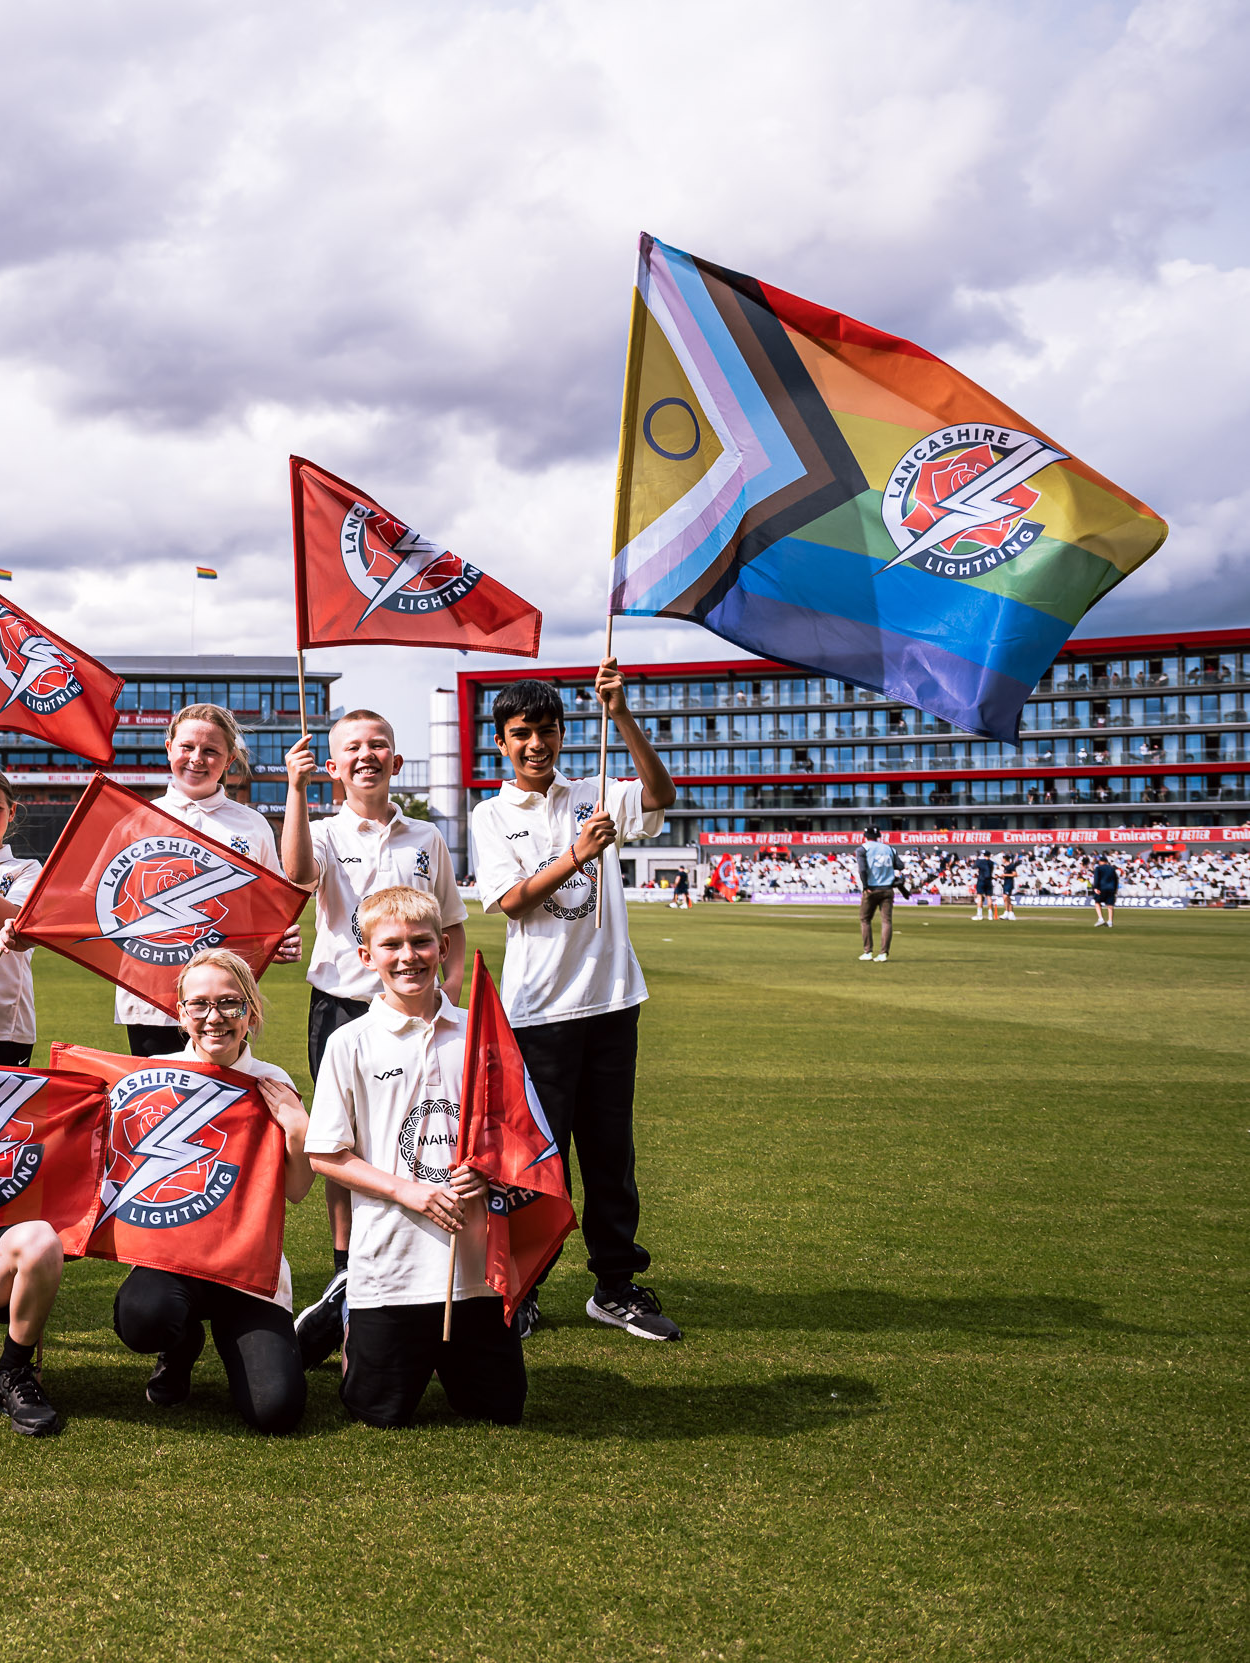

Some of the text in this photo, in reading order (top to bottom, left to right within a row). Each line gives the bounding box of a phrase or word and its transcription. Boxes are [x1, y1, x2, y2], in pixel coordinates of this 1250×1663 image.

[889, 428, 1011, 498] LANCASHIRE
[924, 530, 1034, 575] LIGHTNING
[398, 566, 481, 610] LIGHTNIN
[708, 834, 753, 844] Emirates
[755, 834, 767, 844] FLY
[802, 833, 849, 844] Emirates
[901, 833, 949, 843] Emirates
[952, 832, 964, 842] FLY
[965, 832, 991, 843] BETTER
[1003, 831, 1054, 842] Emirates
[1056, 831, 1070, 842] FLY
[1070, 830, 1098, 842] BETTER
[1110, 830, 1163, 842] Emirates
[1181, 829, 1210, 841] BETTER
[104, 840, 212, 888] LANCASHIRE
[558, 877, 587, 890] AHAL
[1019, 896, 1088, 906] INSURANCE
[111, 1072, 191, 1110] CASHIRE
[129, 1171, 233, 1225] LIGHTNING
